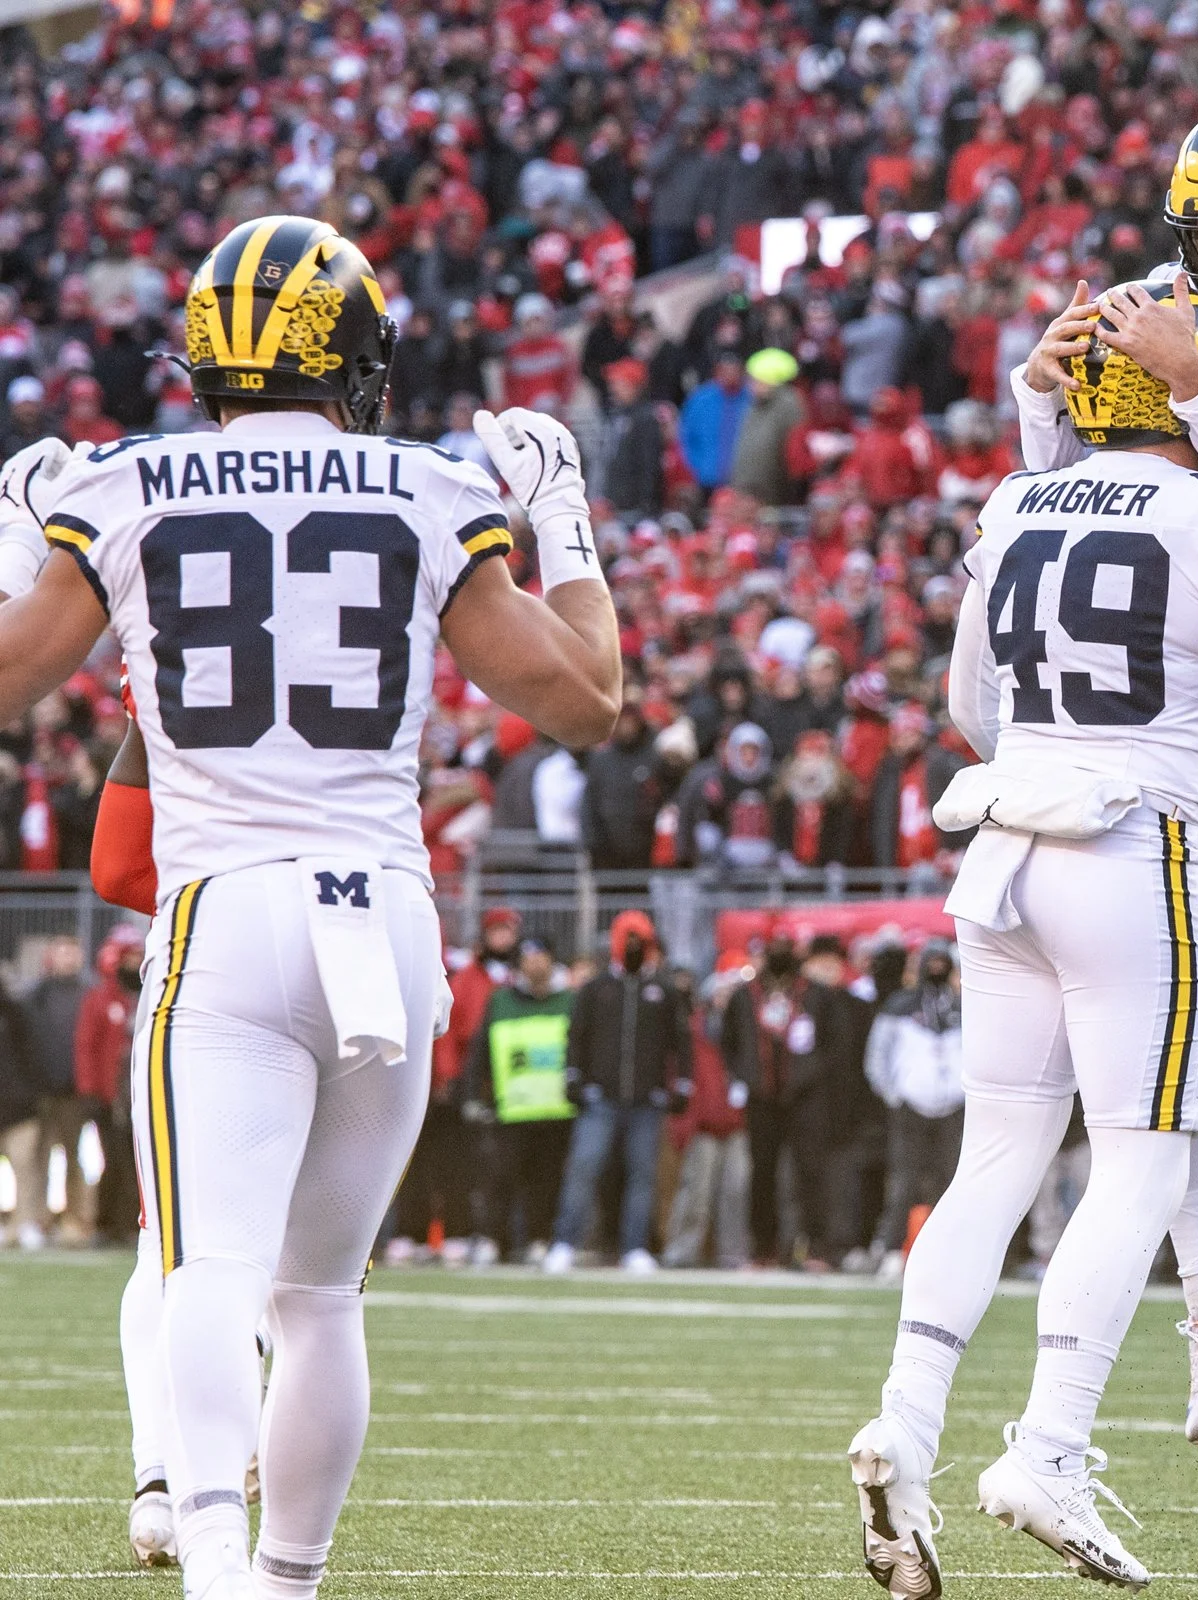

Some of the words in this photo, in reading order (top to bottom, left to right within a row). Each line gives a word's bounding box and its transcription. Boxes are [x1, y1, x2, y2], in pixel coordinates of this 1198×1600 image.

[136, 449, 415, 507] MARSHALL
[1016, 478, 1160, 517] WAGNER
[139, 510, 420, 750] 83
[987, 529, 1171, 726] 49
[313, 871, 370, 909] M
